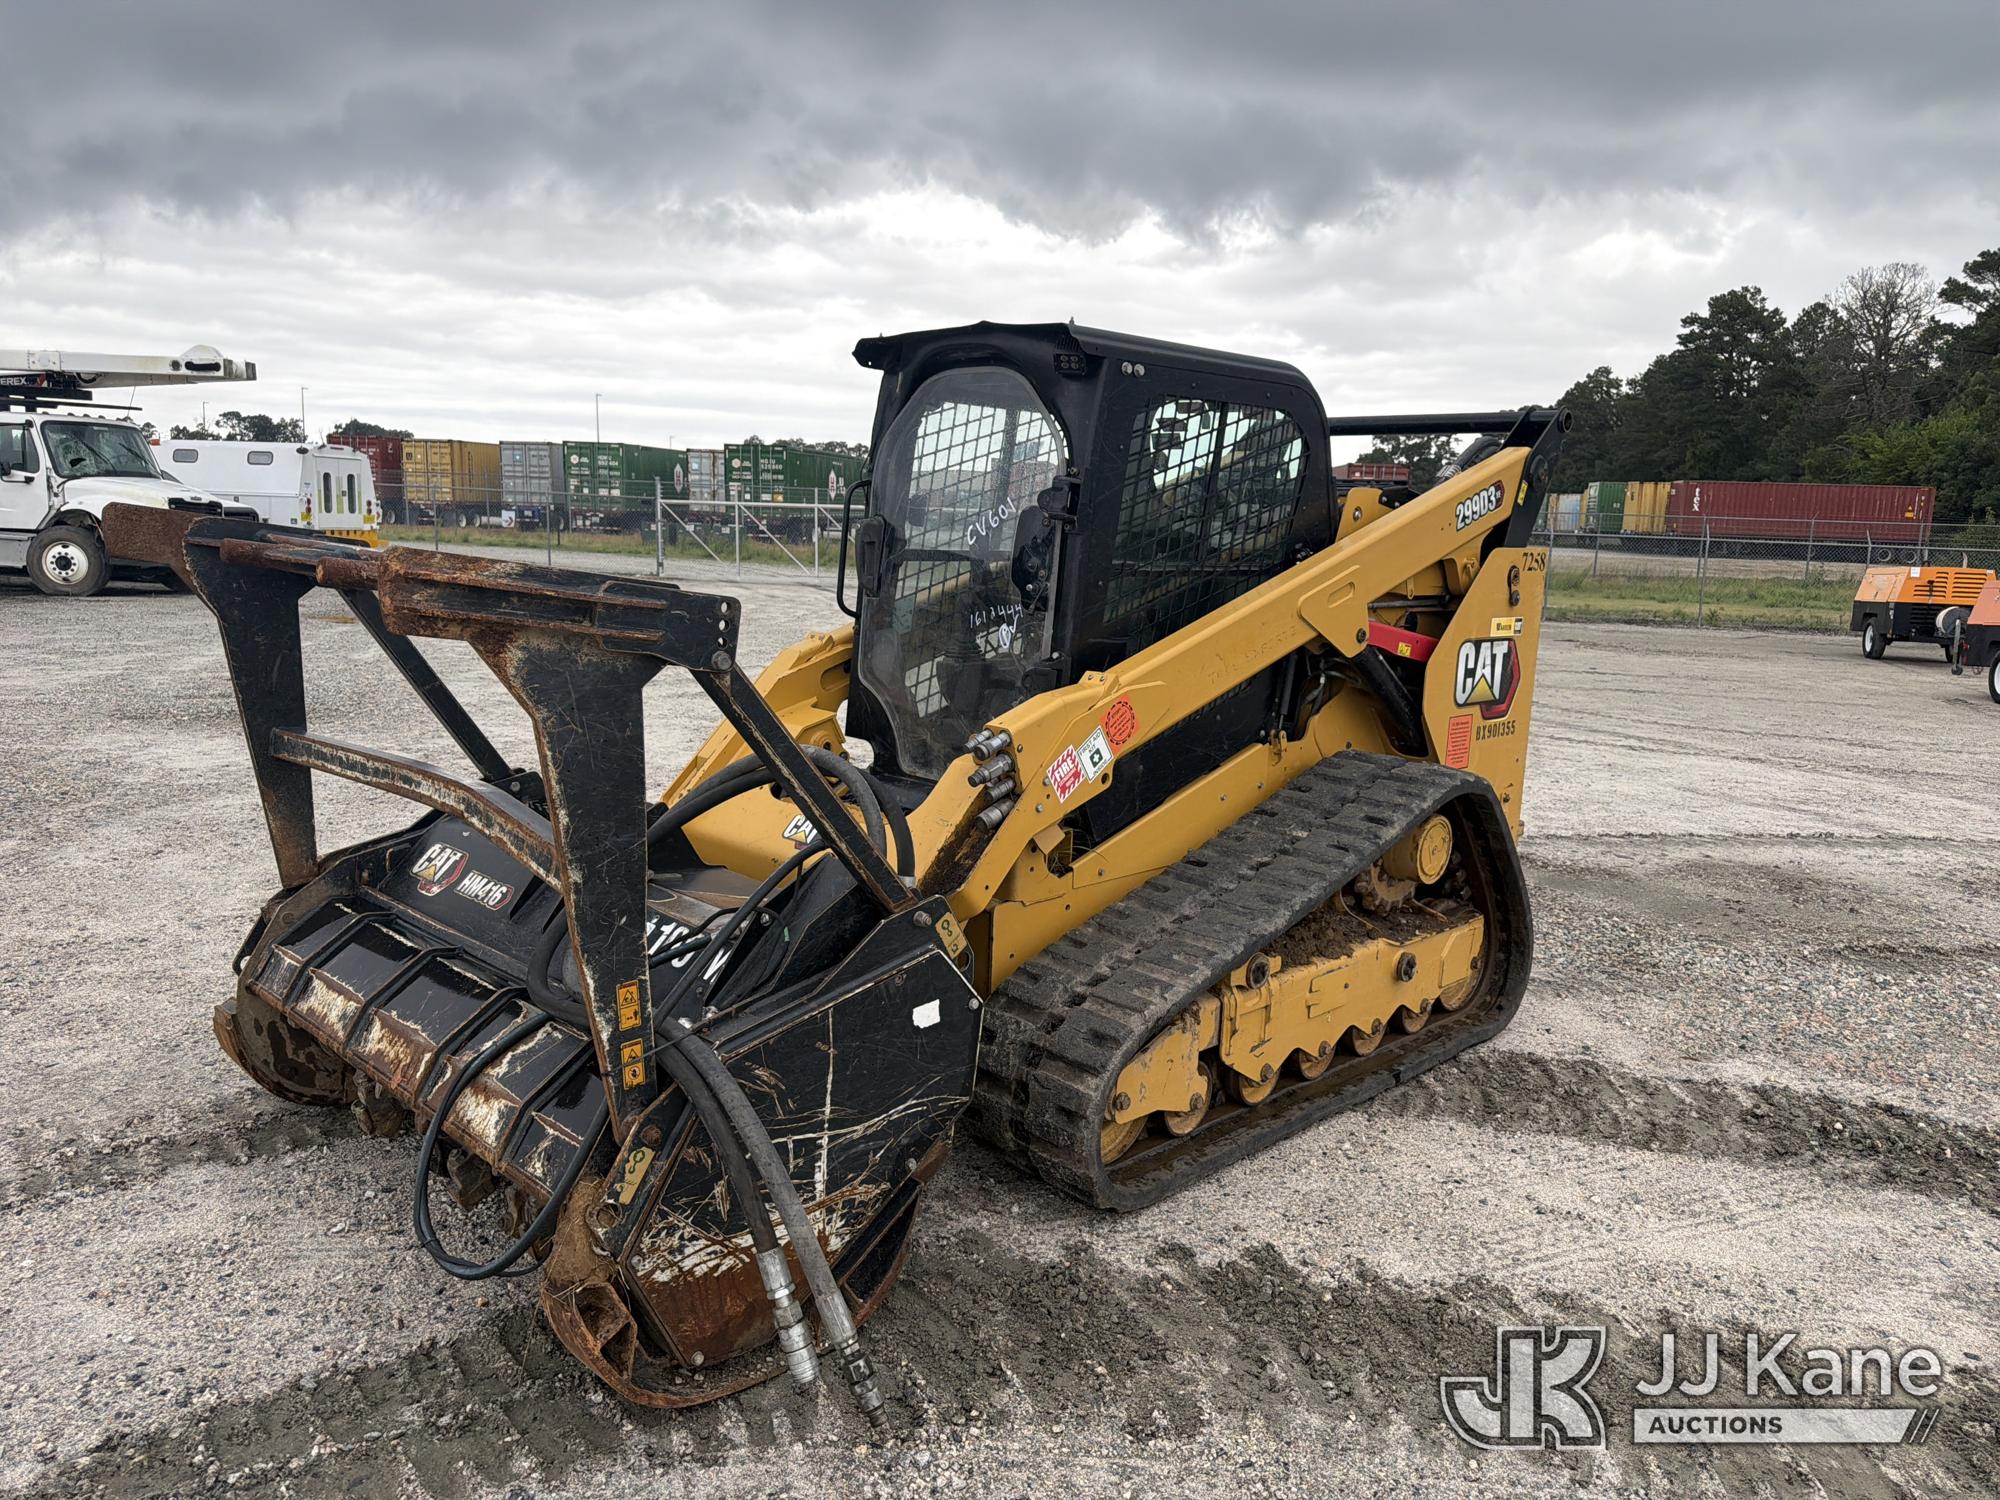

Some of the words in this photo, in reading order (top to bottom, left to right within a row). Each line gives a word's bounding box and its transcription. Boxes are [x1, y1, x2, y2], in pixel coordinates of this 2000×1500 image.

[967, 496, 1017, 545] CV601
[1456, 485, 1497, 531] 299D3
[1521, 552, 1546, 572] 7258
[1456, 640, 1509, 705] CAT
[1053, 757, 1076, 782] FIRE
[413, 843, 463, 882] CAT
[457, 871, 508, 906] HM416
